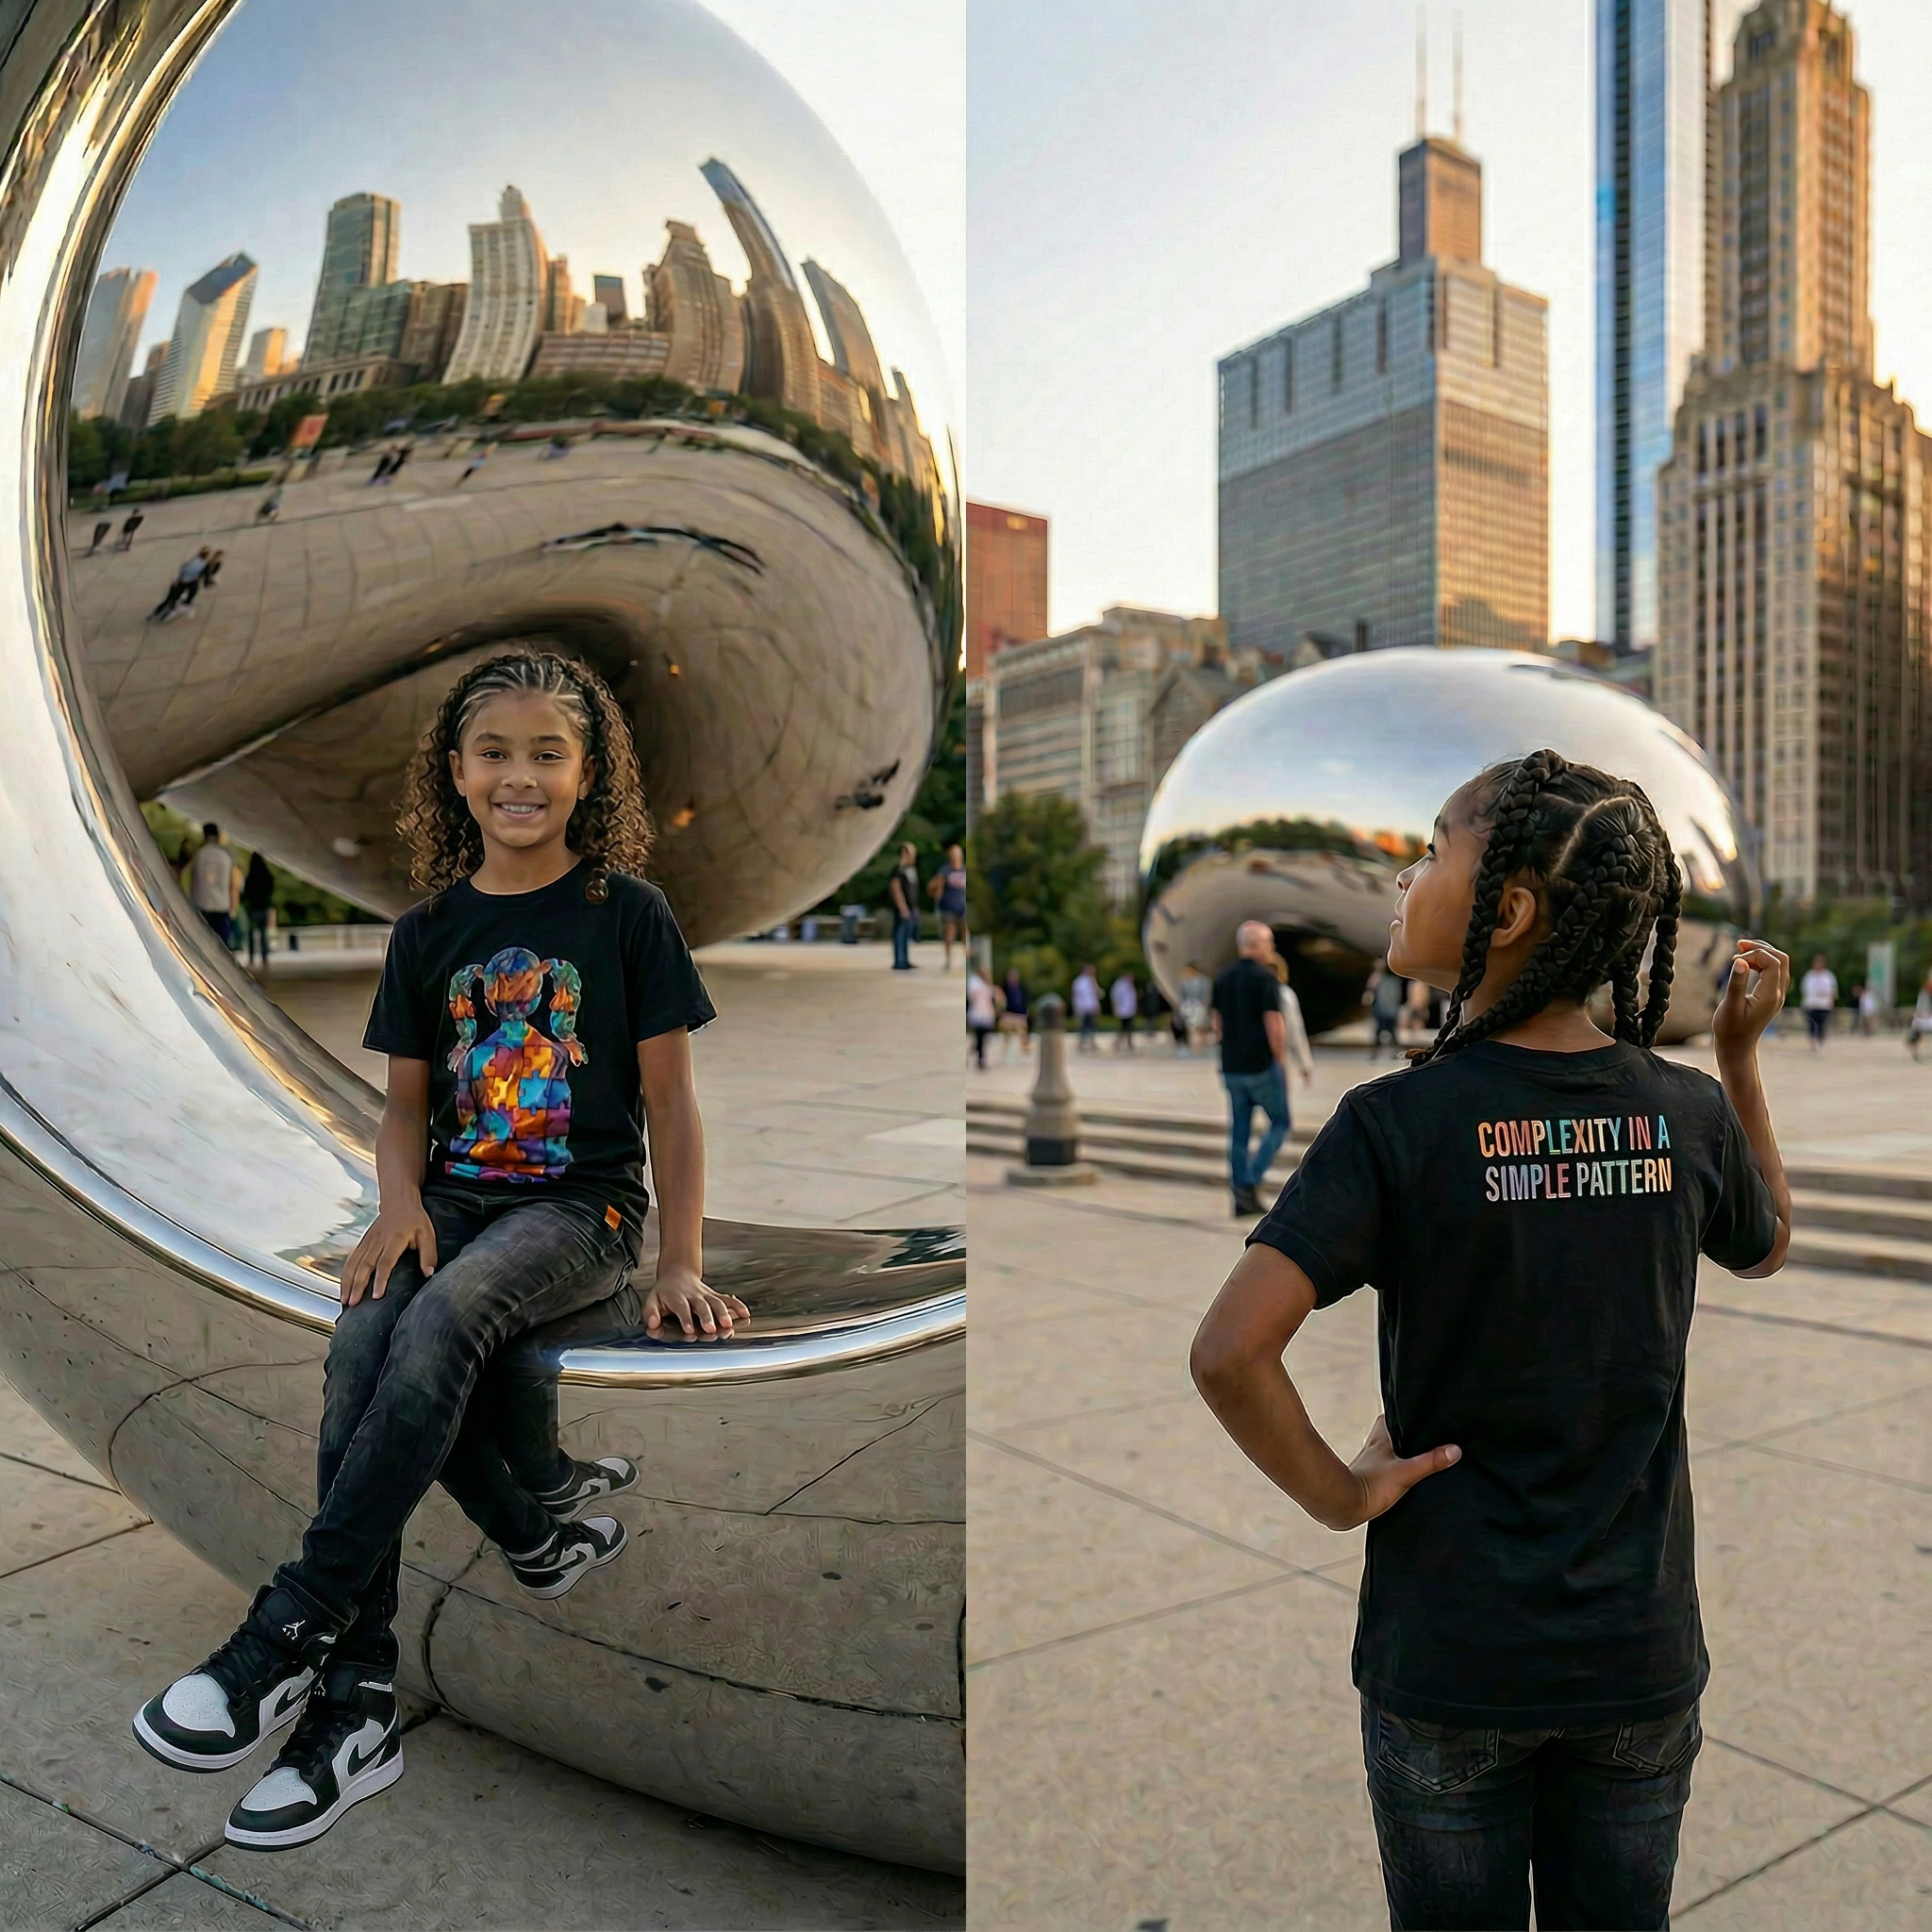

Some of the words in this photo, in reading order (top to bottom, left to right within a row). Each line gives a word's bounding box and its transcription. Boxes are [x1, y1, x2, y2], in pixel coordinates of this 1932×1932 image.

[1477, 1117, 1622, 1158] COMPLEXITY
[1628, 1115, 1651, 1151] IN
[1657, 1115, 1671, 1149] A
[1485, 1162, 1572, 1202] SIMPLE
[1576, 1158, 1672, 1197] PATTERN
